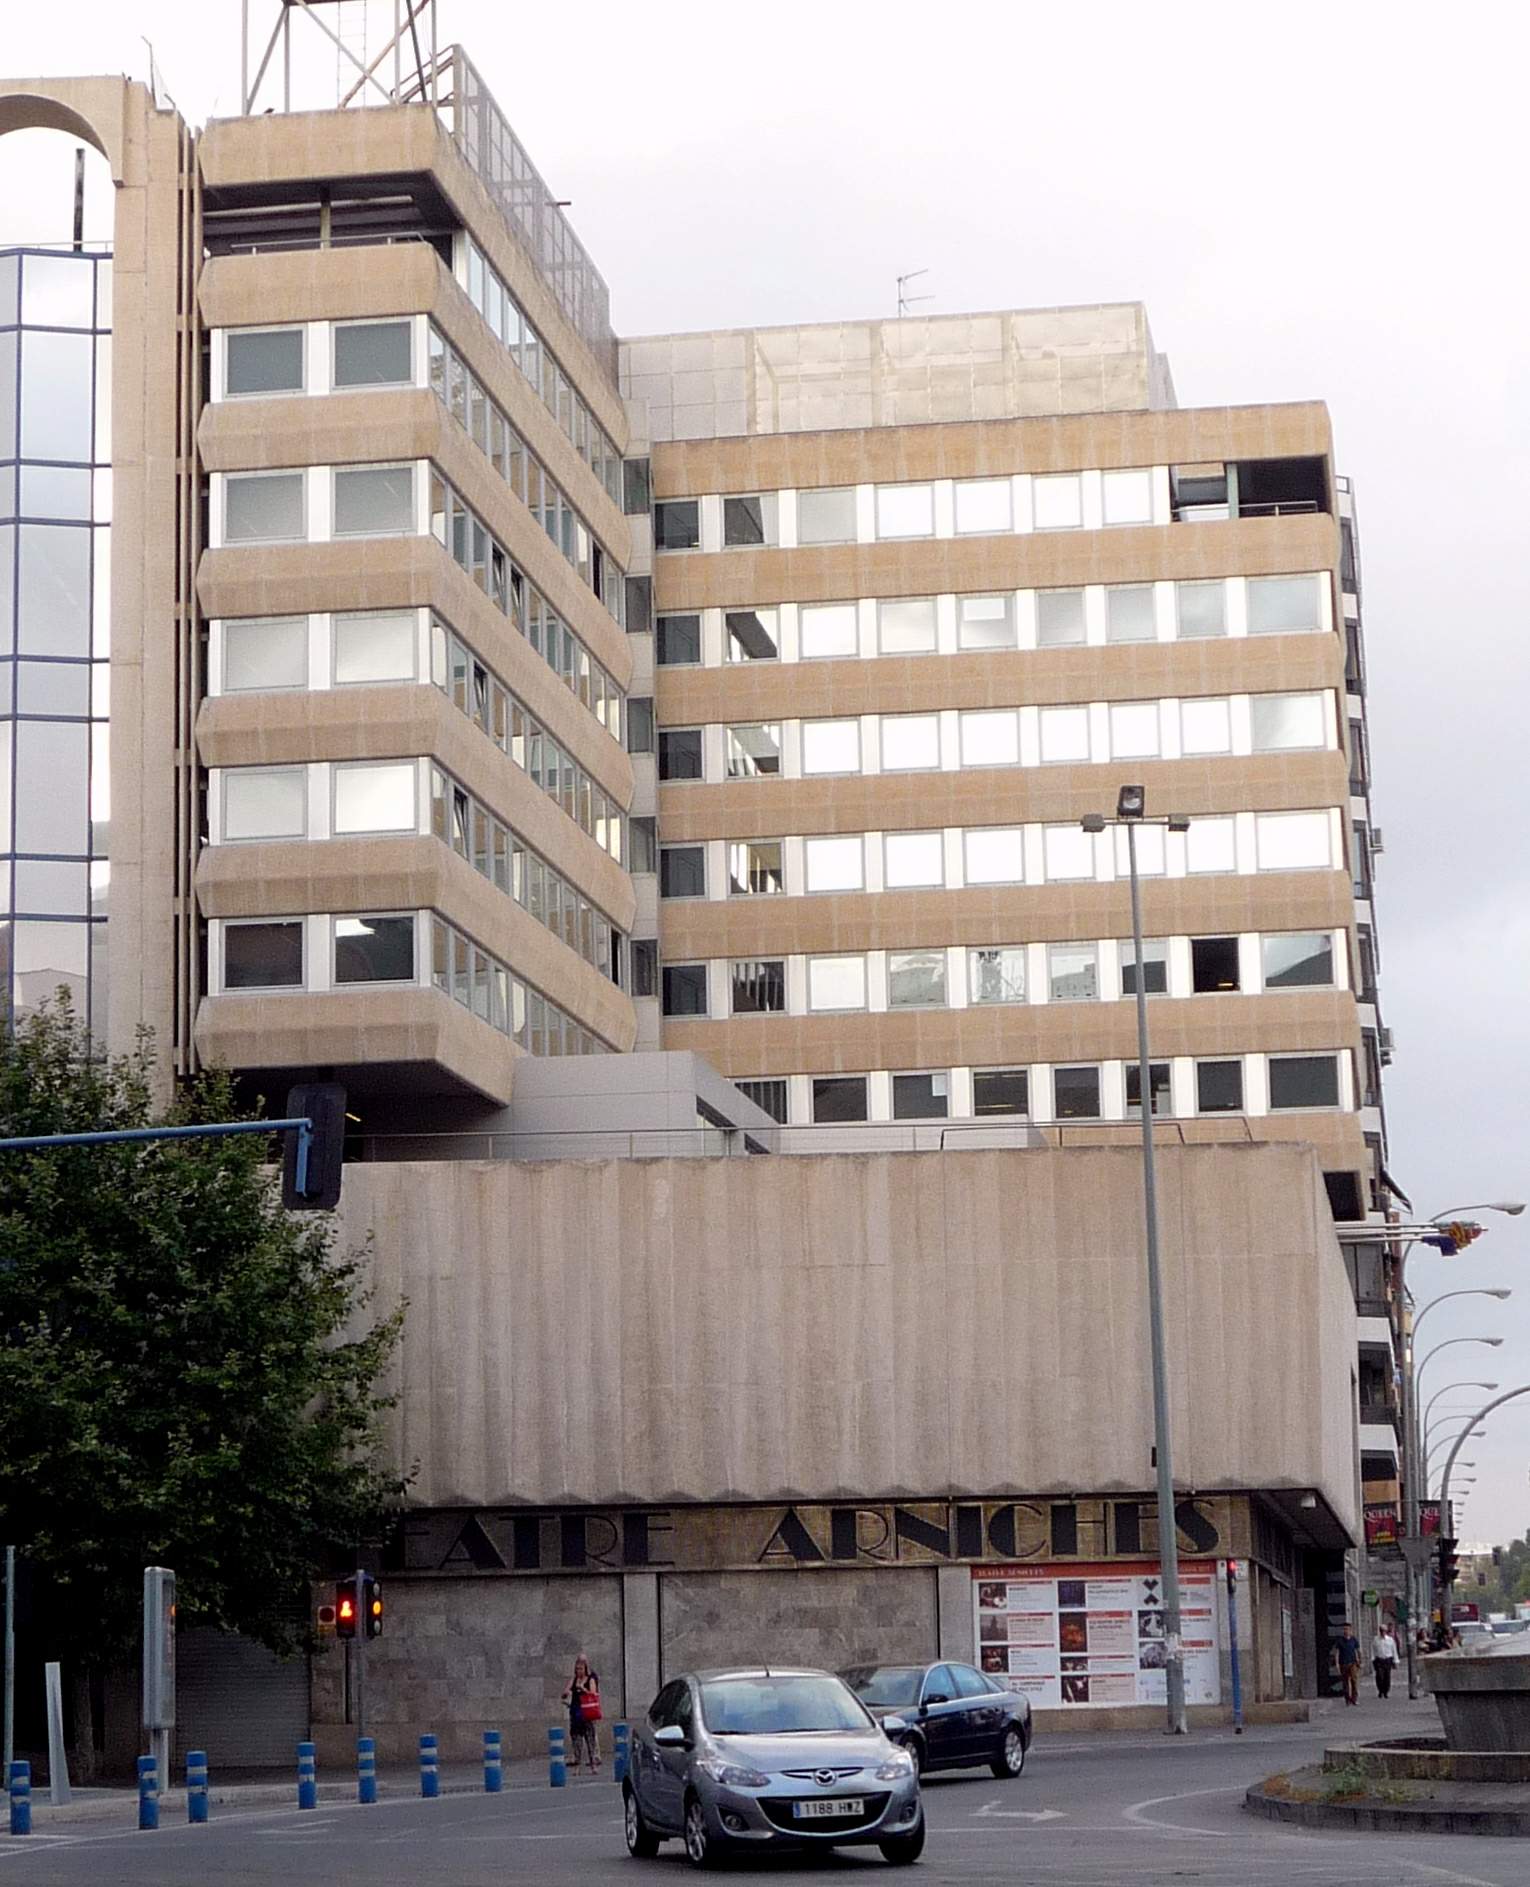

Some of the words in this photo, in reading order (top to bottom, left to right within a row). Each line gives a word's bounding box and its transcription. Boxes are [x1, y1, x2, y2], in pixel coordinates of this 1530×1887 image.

[1364, 1508, 1397, 1523] QUEEN
[758, 1498, 1220, 1564] ARNICHES
[805, 1802, 833, 1815] 1188
